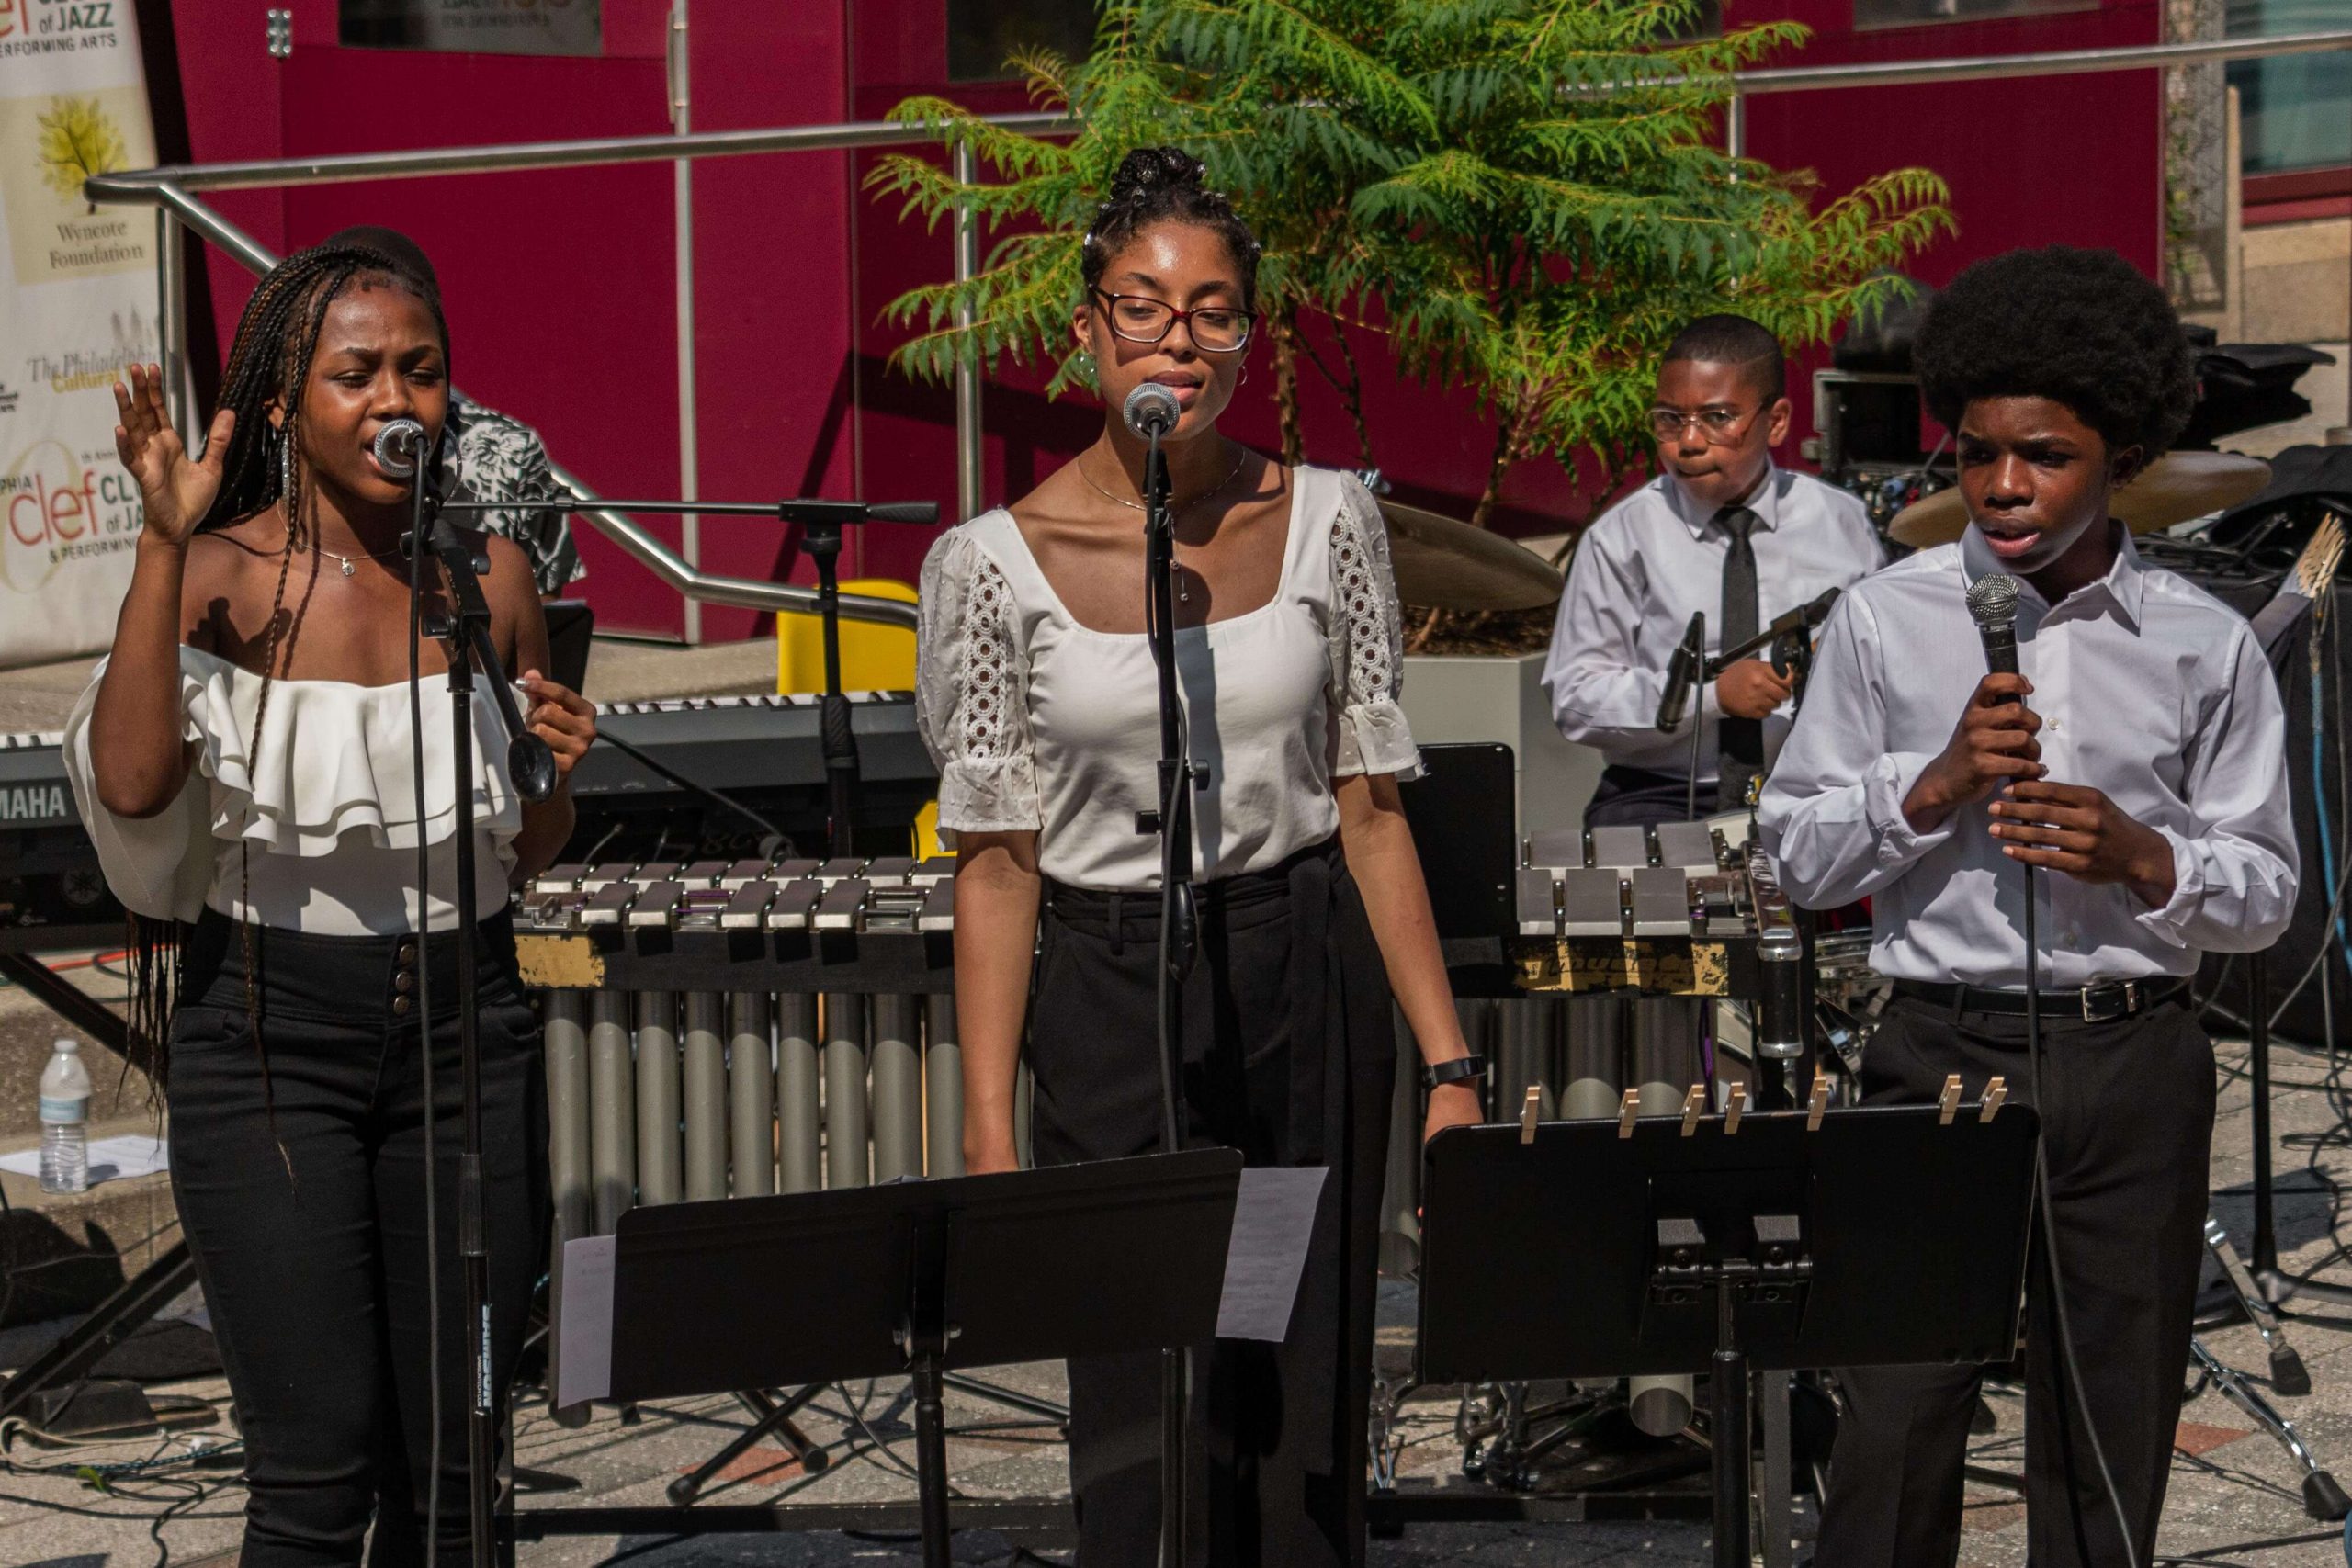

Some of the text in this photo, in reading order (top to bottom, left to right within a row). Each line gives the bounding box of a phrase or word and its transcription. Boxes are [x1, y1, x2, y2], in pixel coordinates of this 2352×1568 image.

[40, 15, 52, 34] of
[58, 3, 114, 32] JAZZ
[80, 33, 117, 50] ARTS
[57, 221, 128, 244] Wyncote
[49, 243, 145, 269] Foundation
[27, 357, 61, 382] The
[51, 369, 120, 393] Cultural
[9, 469, 143, 547] clef CL
[106, 504, 144, 536] of JA
[61, 538, 136, 561] PERFORMIN
[482, 1304, 492, 1407] SAMSON
